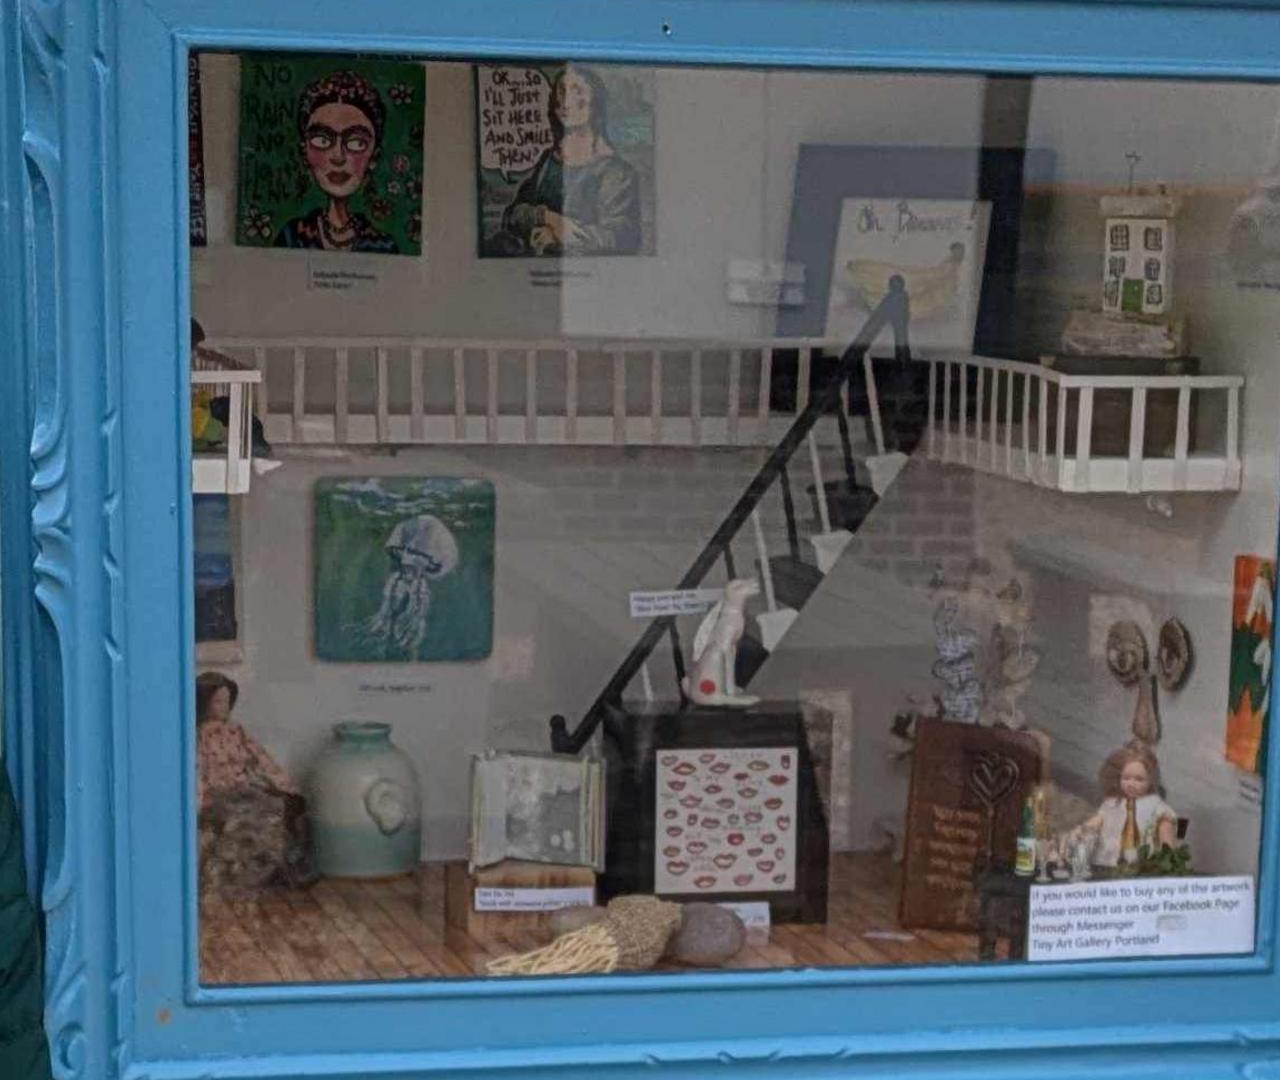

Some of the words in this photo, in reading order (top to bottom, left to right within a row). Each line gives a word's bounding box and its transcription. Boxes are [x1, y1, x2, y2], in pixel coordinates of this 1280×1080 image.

[254, 63, 293, 90] NO
[484, 87, 506, 107] I'LL
[507, 108, 542, 126] HERE
[484, 129, 515, 146] AND
[1042, 891, 1062, 902] you
[1064, 889, 1096, 900] would
[1099, 888, 1117, 898] like
[1120, 888, 1132, 897] to
[1134, 887, 1153, 898] buy
[1156, 886, 1175, 897] any
[1178, 885, 1188, 894] of
[1191, 884, 1208, 893] the
[1211, 882, 1249, 892] artwork
[1031, 907, 1065, 919] please
[1068, 905, 1107, 915] contact
[1110, 905, 1123, 913] us
[1126, 905, 1140, 913] on
[1142, 903, 1159, 912] our
[1163, 900, 1211, 911] Facebook
[1215, 899, 1239, 910] Page
[1031, 922, 1074, 934] through
[1077, 919, 1135, 932] Messenger
[1032, 939, 1053, 951] Tiny
[1056, 938, 1072, 949] Art
[1075, 936, 1111, 950] Gallery
[1115, 934, 1160, 945] Portland
